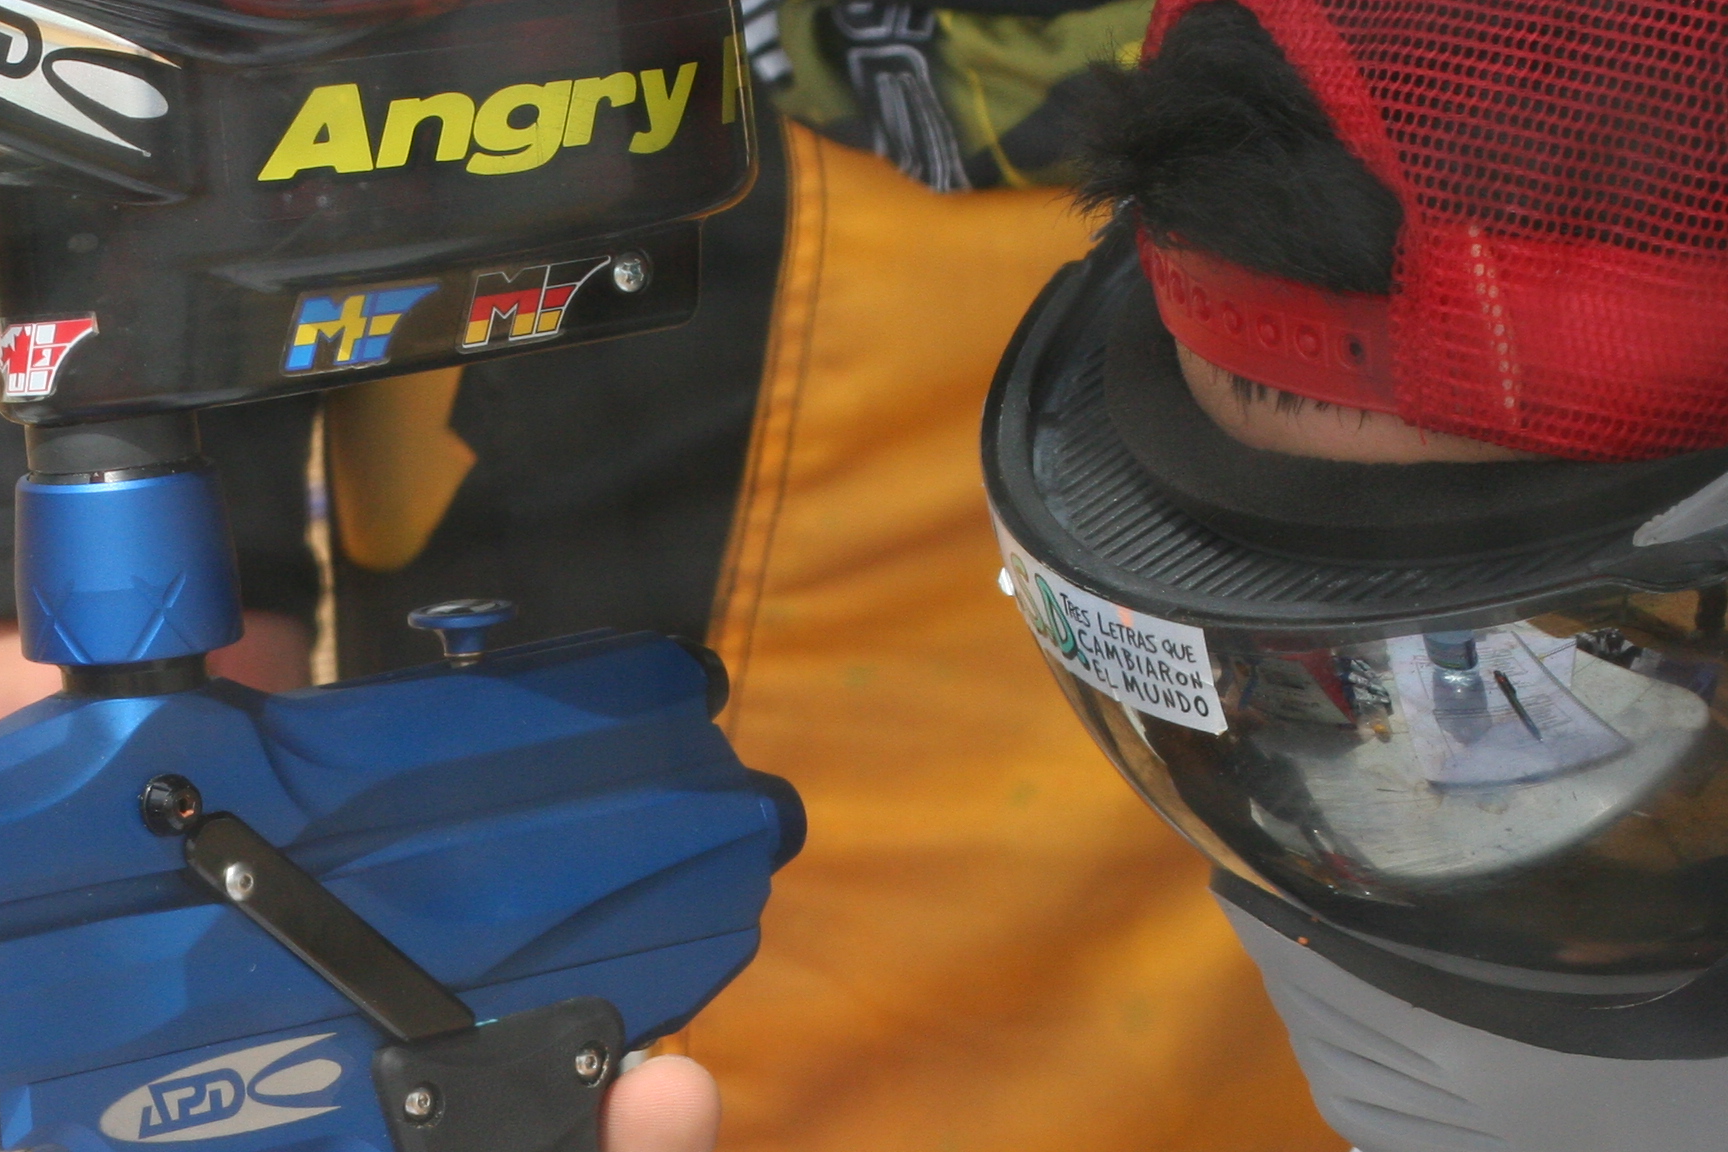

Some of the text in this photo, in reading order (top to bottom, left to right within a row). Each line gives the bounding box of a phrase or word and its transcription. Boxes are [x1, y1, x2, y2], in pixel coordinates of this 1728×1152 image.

[257, 61, 699, 181] Angry
[1060, 592, 1197, 663] TRES LETRAS QUE
[1078, 629, 1203, 689] CAMBIARON
[1092, 658, 1209, 717] EL MUNDO
